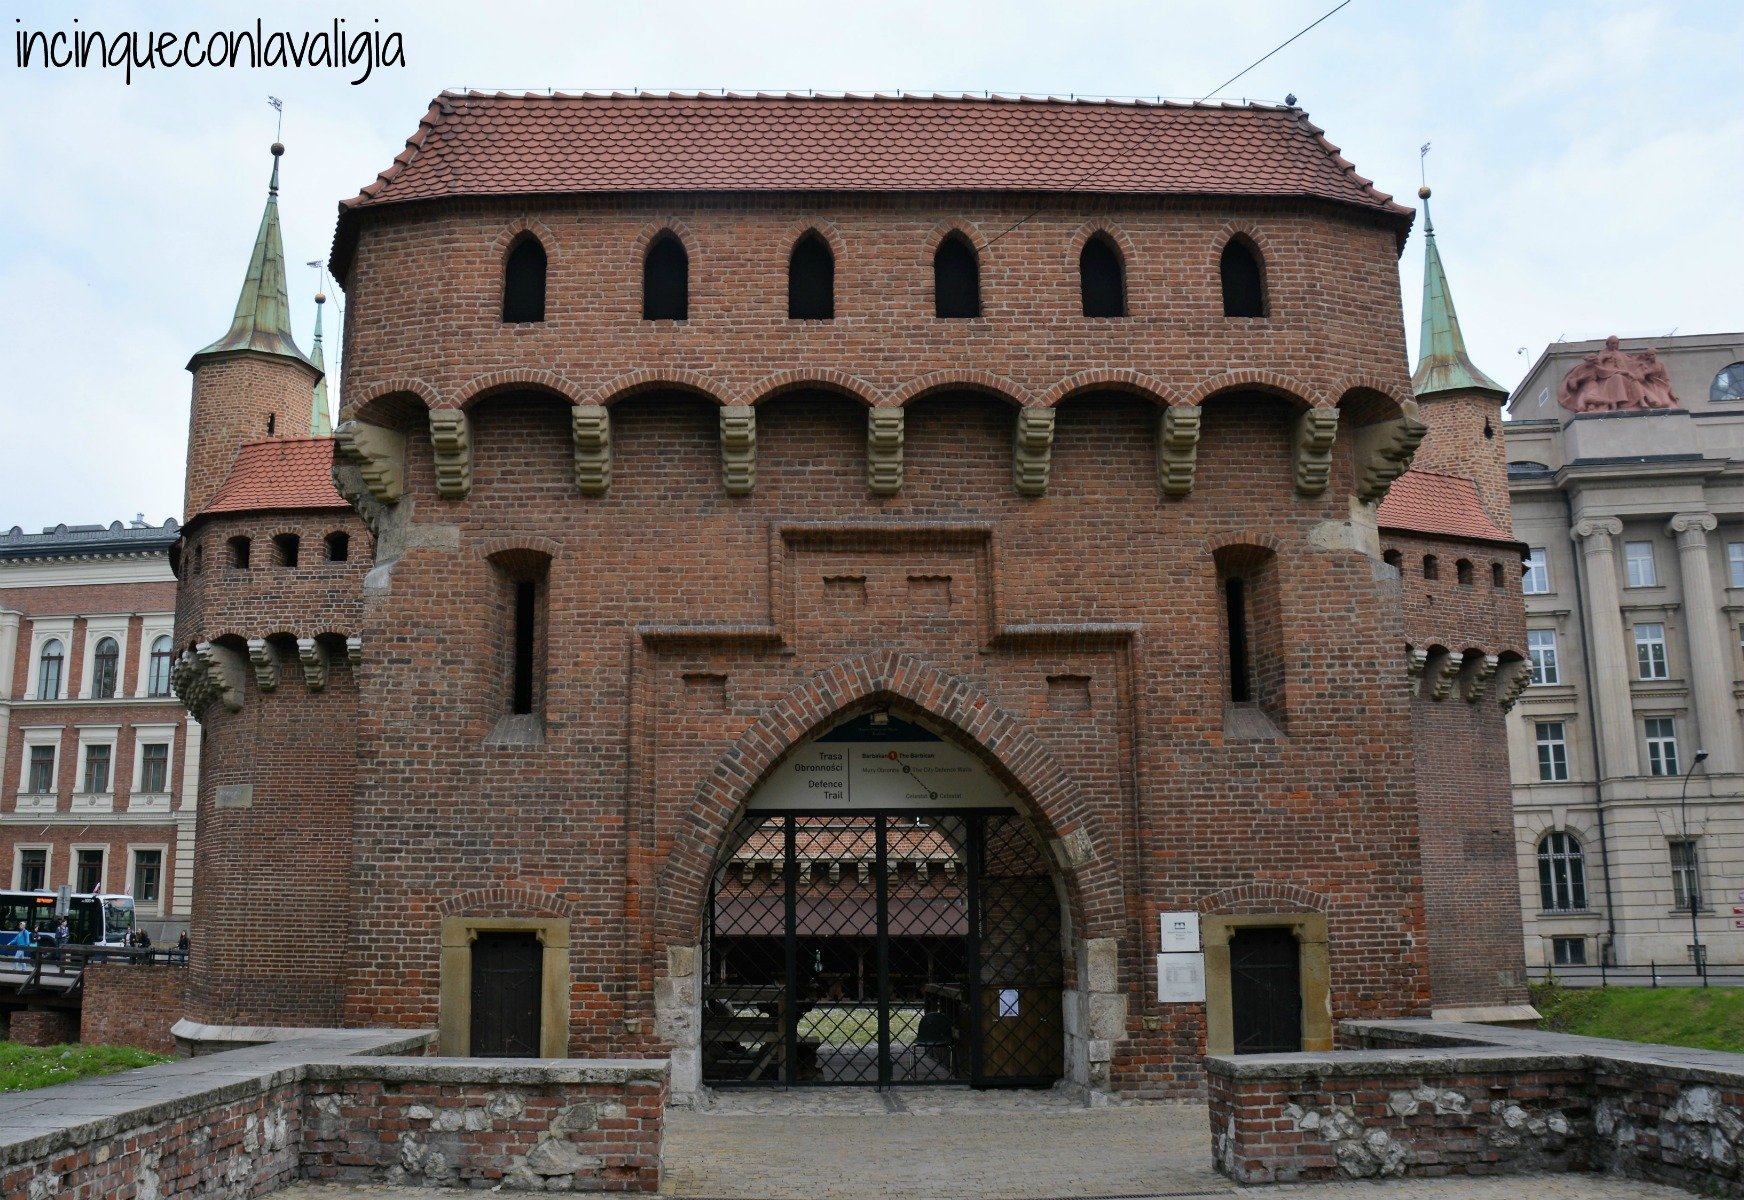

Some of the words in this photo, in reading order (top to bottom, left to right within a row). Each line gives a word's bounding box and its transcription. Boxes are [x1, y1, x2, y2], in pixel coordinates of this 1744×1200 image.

[820, 752, 843, 760] Trasa
[794, 763, 843, 772] Obronności
[808, 780, 843, 788] Defence
[824, 791, 843, 799] Trail
